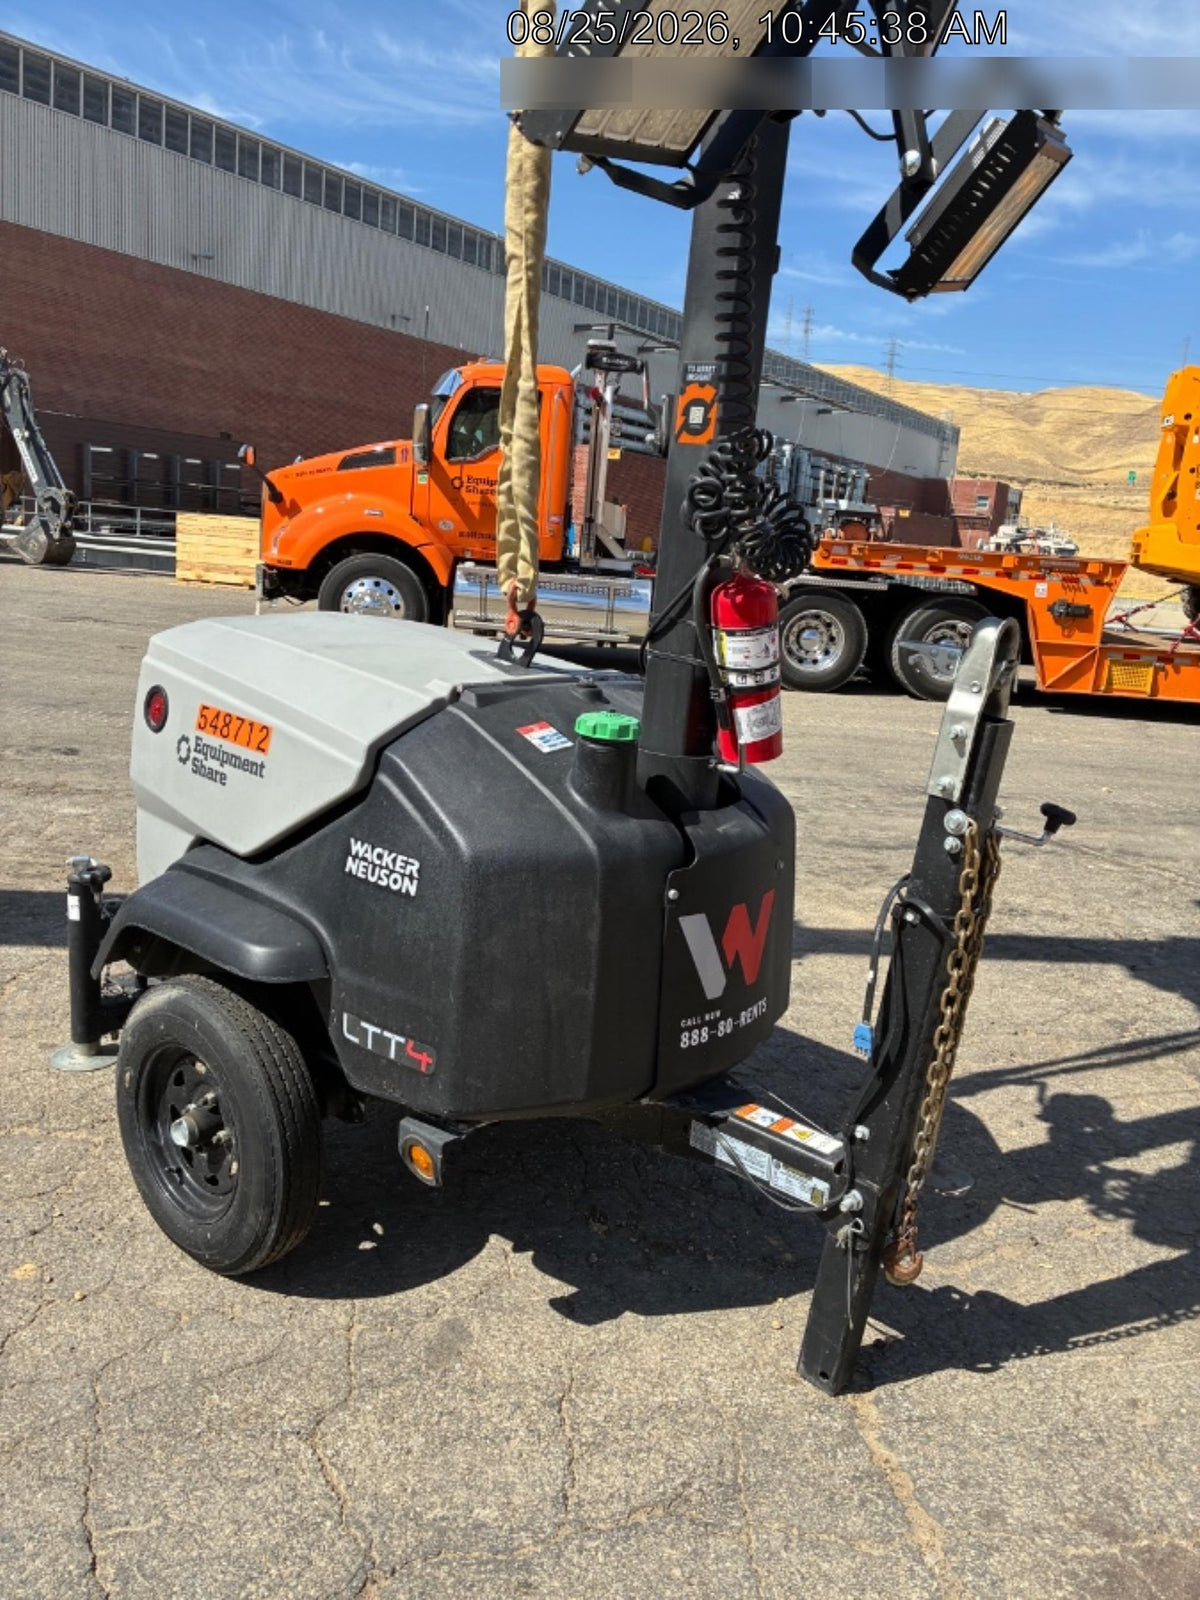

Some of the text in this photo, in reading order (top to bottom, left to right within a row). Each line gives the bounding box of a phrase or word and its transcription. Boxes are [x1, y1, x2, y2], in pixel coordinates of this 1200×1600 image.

[466, 474, 498, 487] Equip
[198, 704, 270, 753] 548712
[191, 756, 227, 786] Share
[193, 735, 265, 779] Equipment
[344, 855, 418, 897] NEUSON
[349, 837, 420, 879] WACKER
[680, 1010, 721, 1028] CALL NOW
[680, 996, 767, 1049] 888-80-RENTS
[342, 1011, 433, 1073] LTT4
